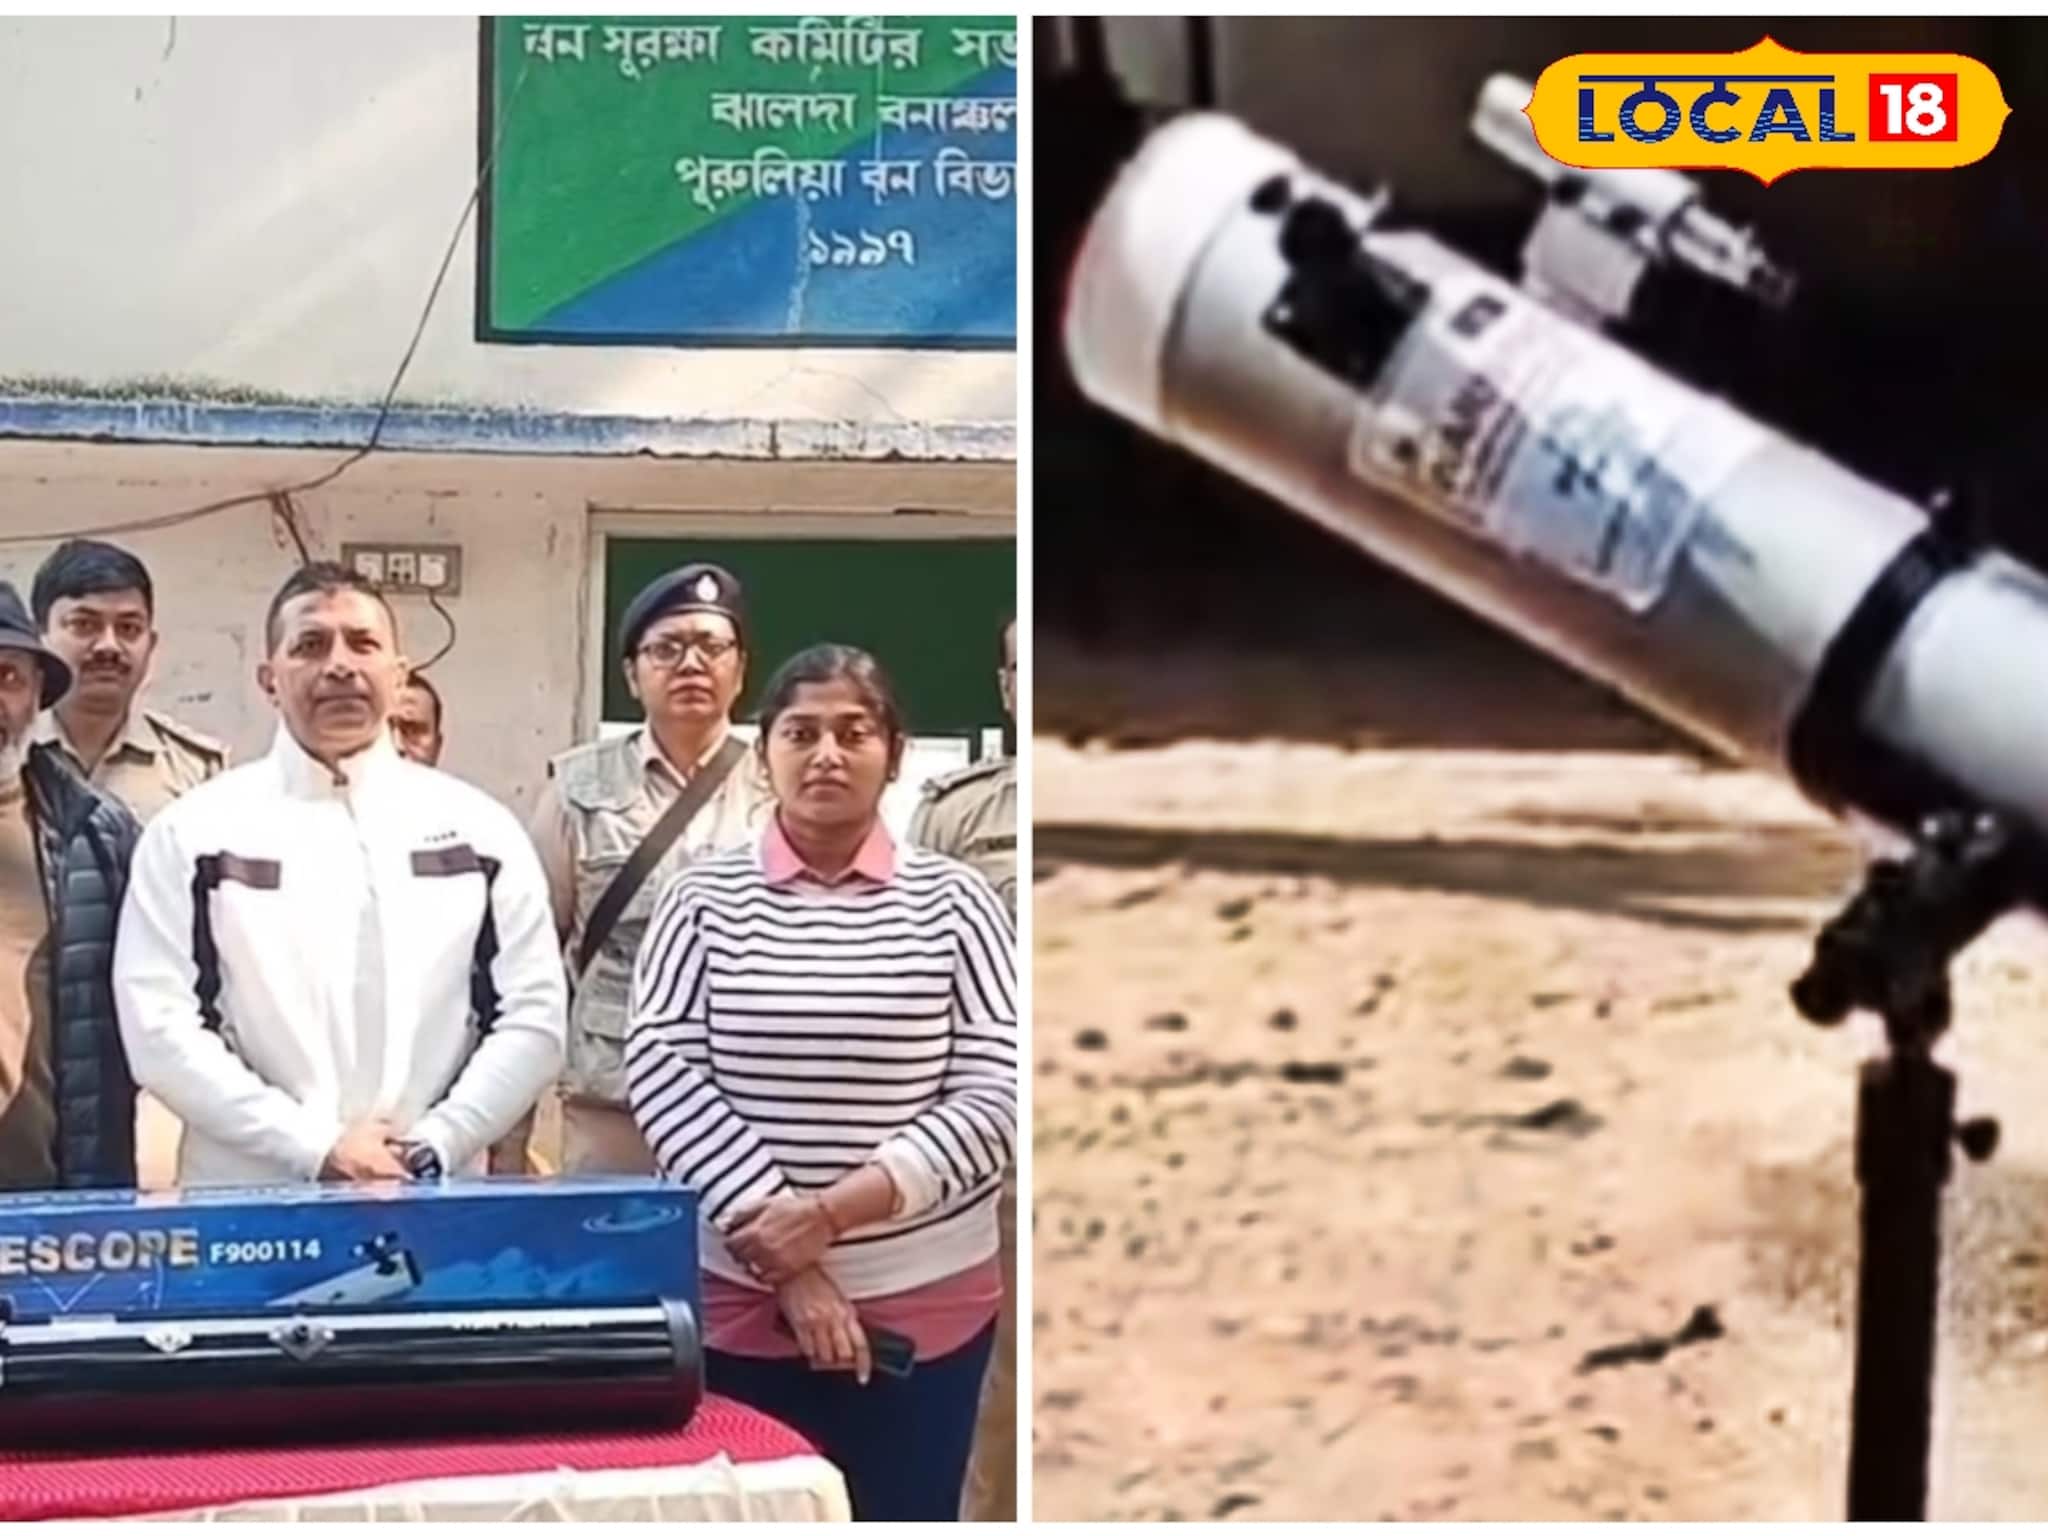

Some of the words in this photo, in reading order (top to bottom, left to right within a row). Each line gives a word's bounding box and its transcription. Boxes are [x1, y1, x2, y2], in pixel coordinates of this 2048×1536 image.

[522, 23, 592, 62] বন
[748, 14, 923, 68] কমিটির
[710, 92, 858, 134] ঝালদা
[860, 159, 922, 199] বন
[808, 228, 916, 267] ১৯৯৭
[0, 1228, 200, 1275] ESCOPE
[210, 1238, 322, 1265] F900114
